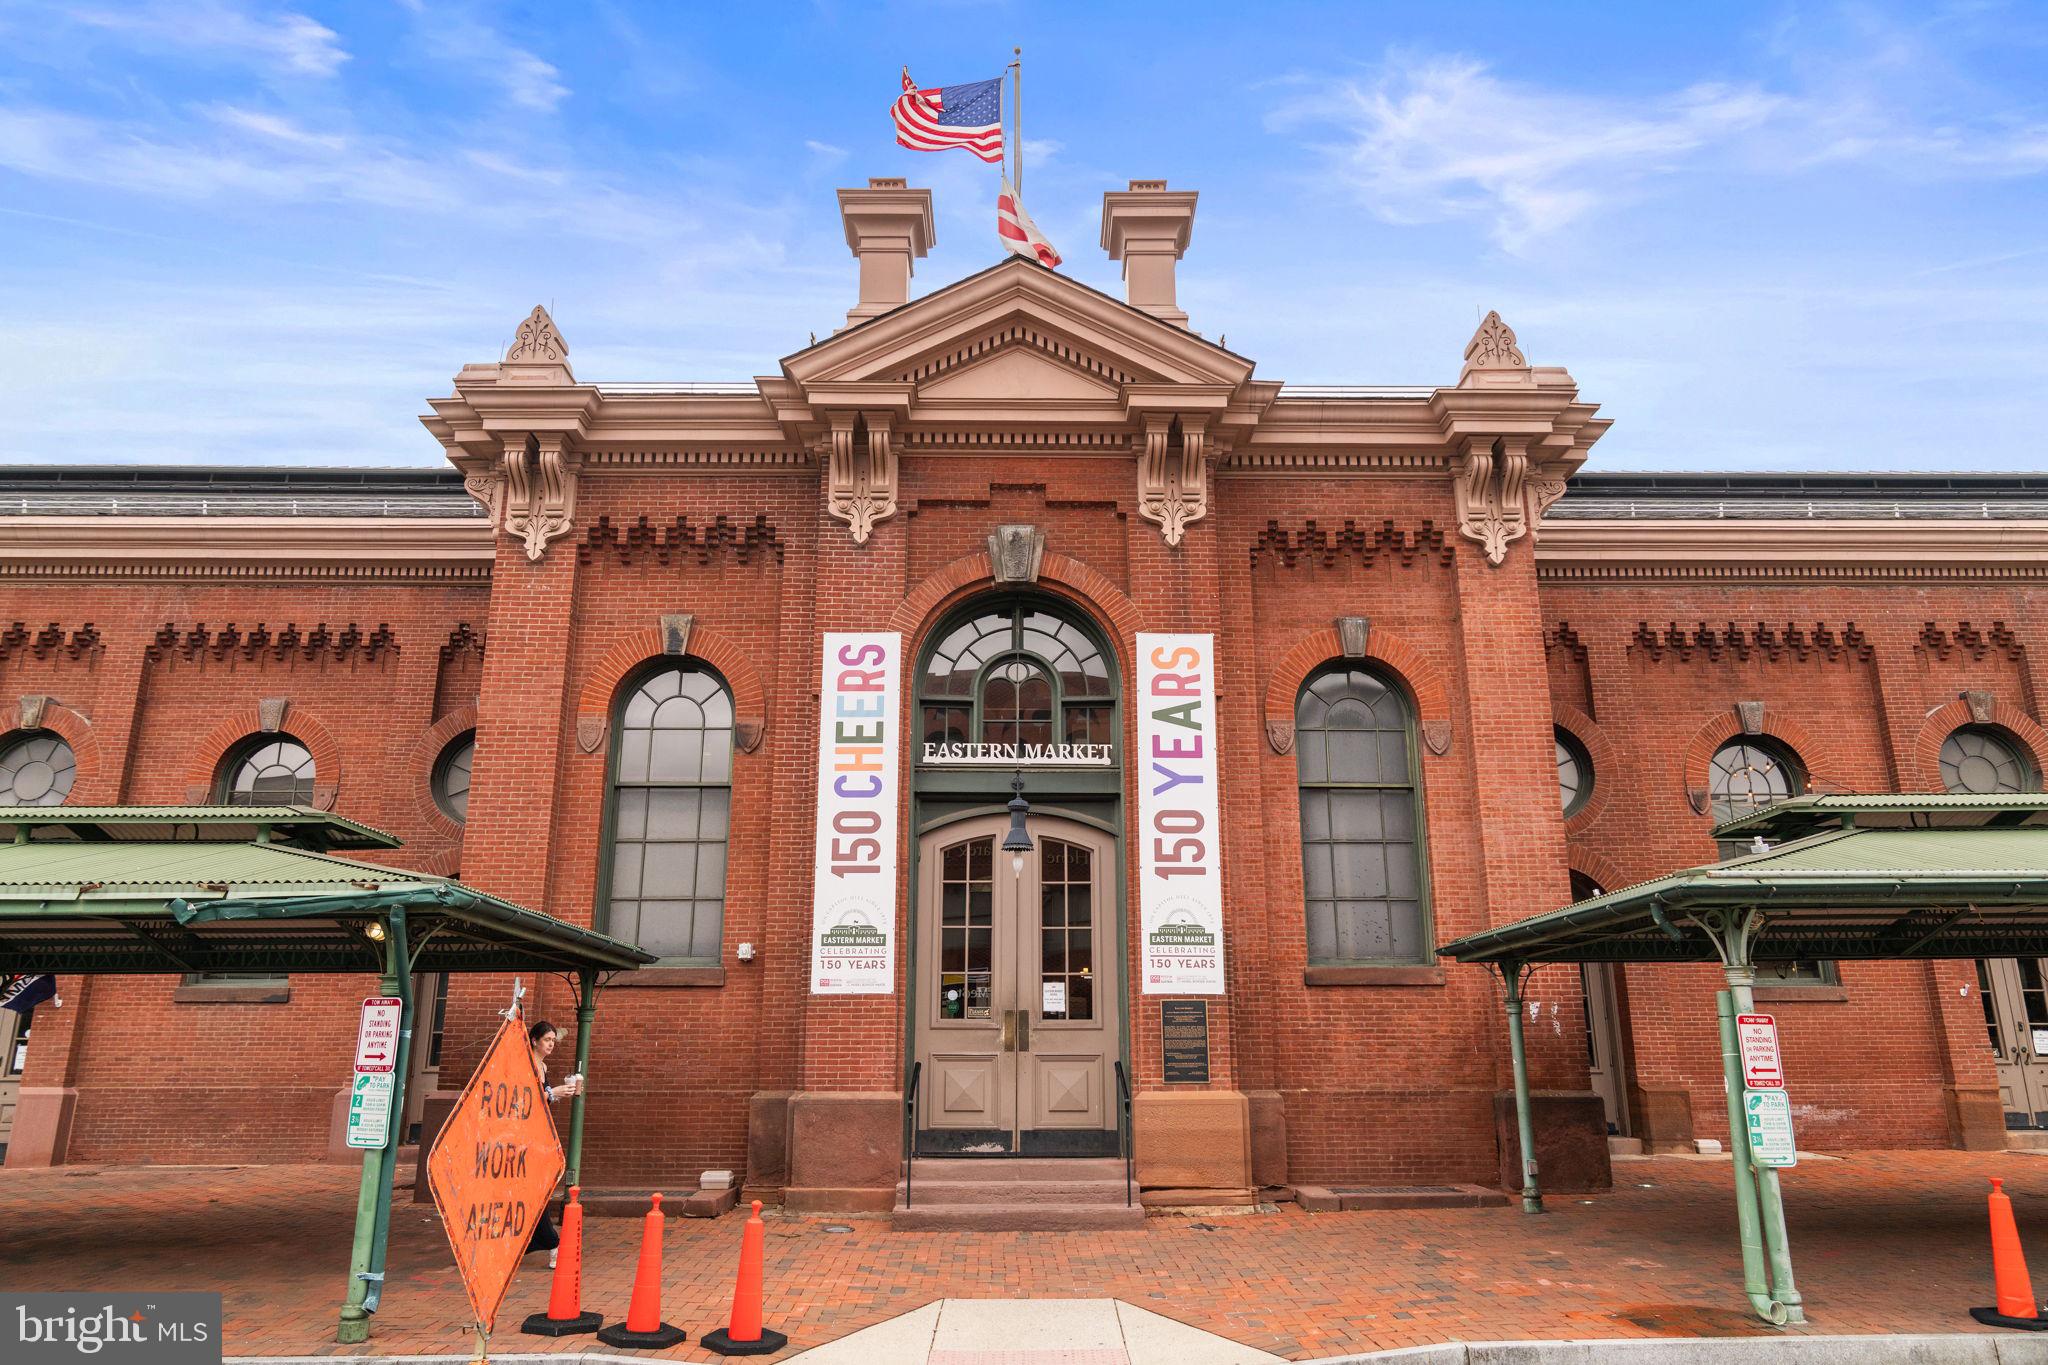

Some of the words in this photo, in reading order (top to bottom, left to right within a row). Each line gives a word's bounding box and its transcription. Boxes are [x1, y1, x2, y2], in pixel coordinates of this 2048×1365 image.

[834, 644, 886, 798] CHEERS
[1150, 646, 1204, 796] YEARS
[923, 742, 1018, 759] EASTERN
[1023, 744, 1112, 760] MARKET
[831, 810, 881, 878] 150
[1153, 809, 1206, 881] 150
[820, 960, 842, 969] 150
[848, 960, 886, 969] YEARS
[1150, 959, 1171, 968] 150
[1178, 959, 1216, 968] YEARS
[355, 1096, 360, 1106] 2
[481, 1080, 533, 1120] ROAD
[1752, 1116, 1757, 1126] 2
[475, 1142, 528, 1179] WORK
[464, 1201, 525, 1242] AHEAD
